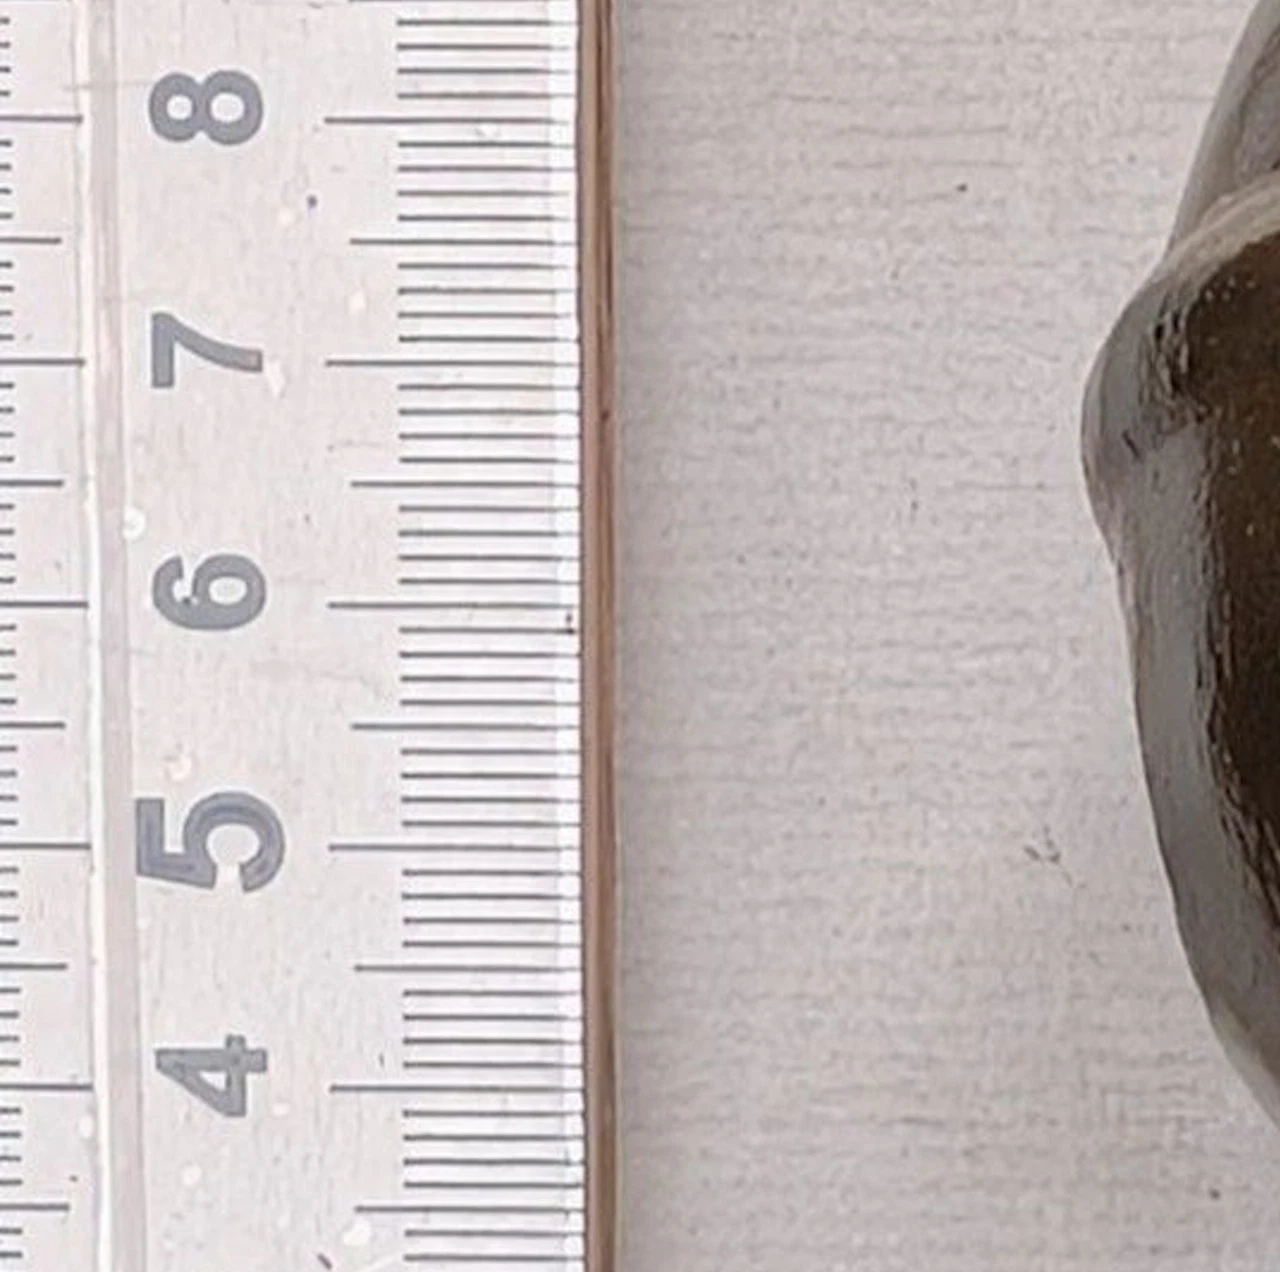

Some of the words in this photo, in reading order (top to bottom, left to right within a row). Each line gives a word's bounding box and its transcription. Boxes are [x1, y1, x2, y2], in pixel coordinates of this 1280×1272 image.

[148, 70, 263, 146] 8
[151, 312, 263, 389] 7
[152, 554, 266, 631] 6
[134, 792, 285, 893] 5
[154, 1034, 268, 1118] 4
